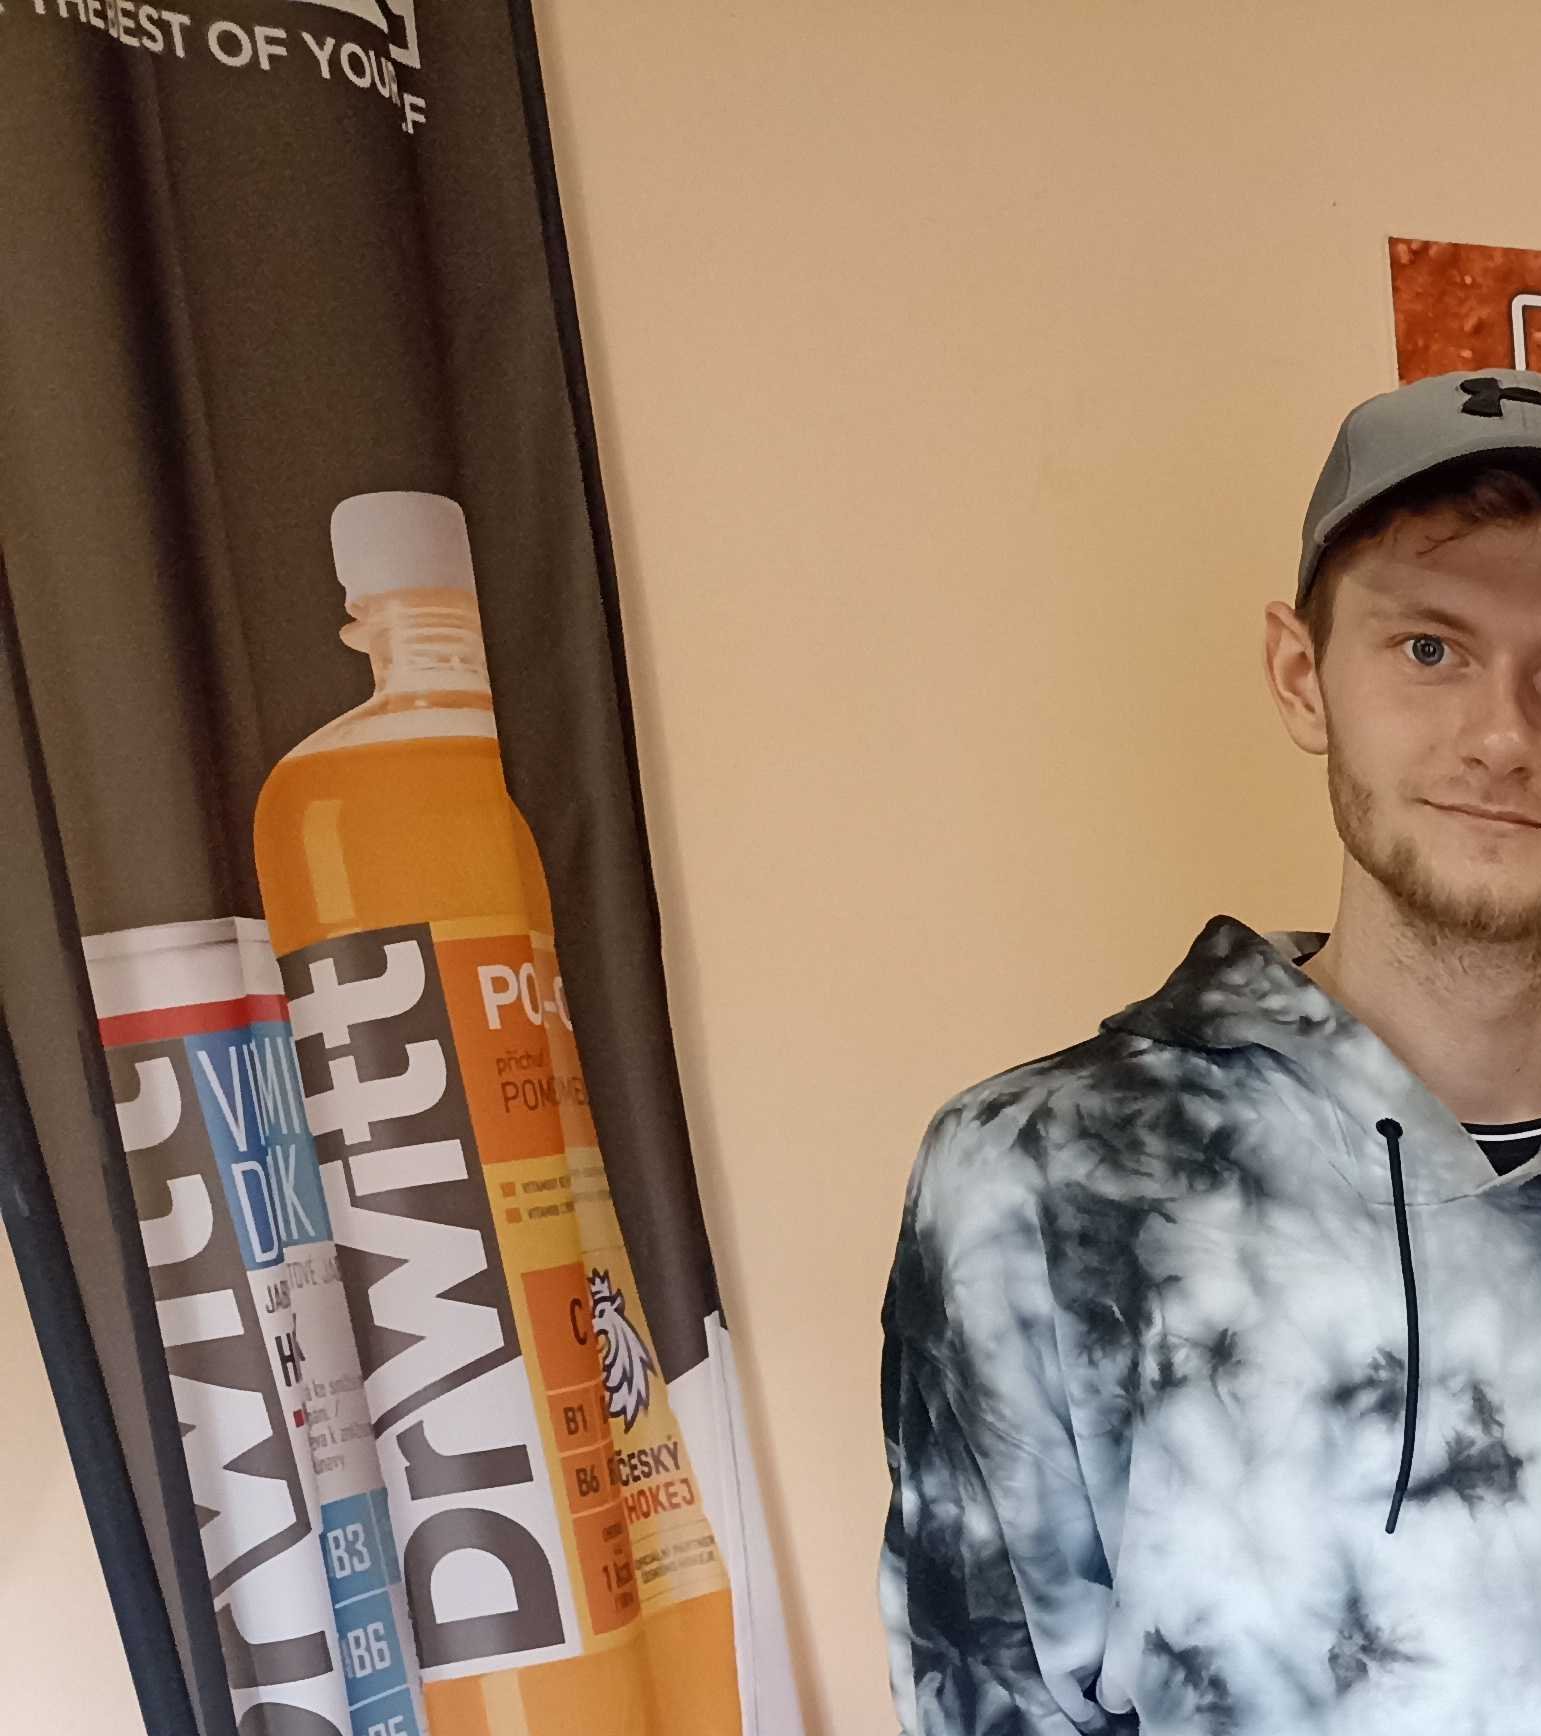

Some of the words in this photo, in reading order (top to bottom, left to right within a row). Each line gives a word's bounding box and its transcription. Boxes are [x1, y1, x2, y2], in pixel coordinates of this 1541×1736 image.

[207, 20, 288, 70] OF
[562, 1404, 588, 1436] B1
[575, 1465, 600, 1498] B6
[615, 1434, 681, 1487] ČESKÝ
[624, 1477, 695, 1525] HOKEJ
[327, 1521, 372, 1580] B3
[348, 1621, 392, 1679] B6
